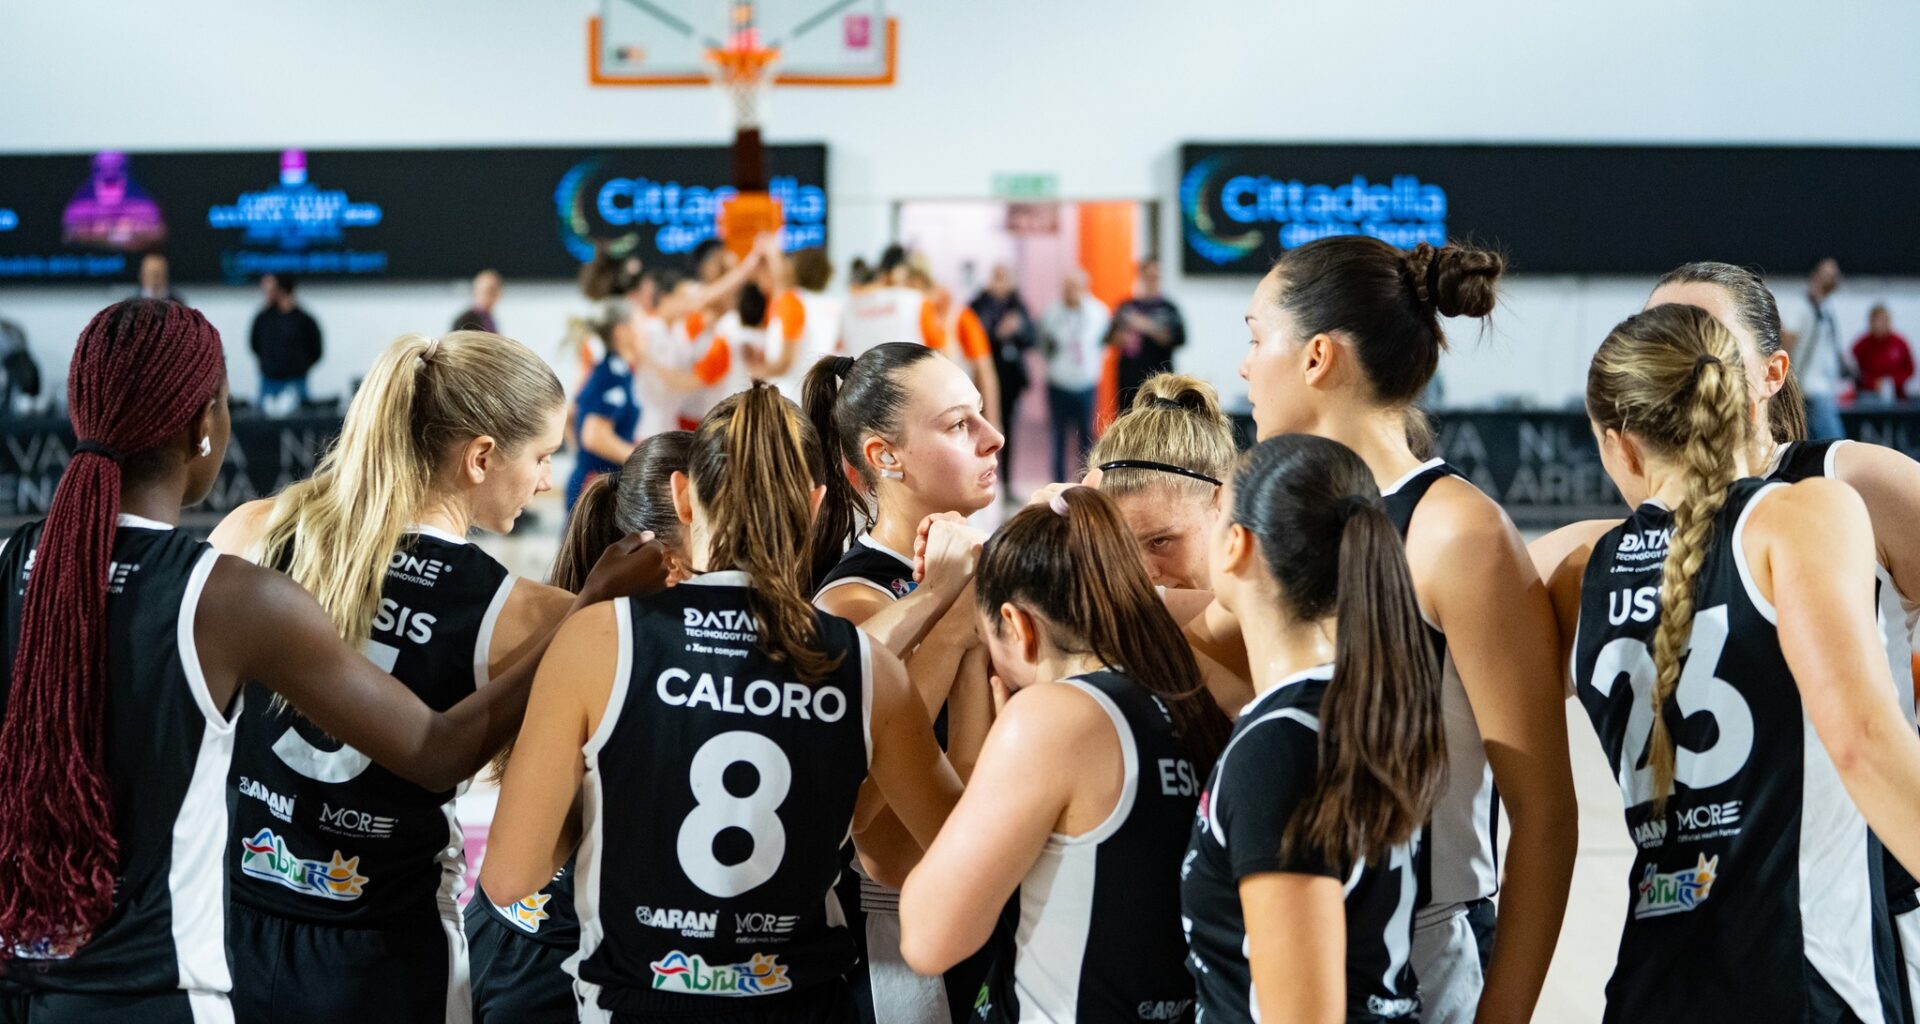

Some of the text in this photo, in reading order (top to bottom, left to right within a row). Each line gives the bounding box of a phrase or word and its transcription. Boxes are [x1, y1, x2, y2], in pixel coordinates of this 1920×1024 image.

[1608, 585, 1663, 626] US
[685, 627, 741, 641] TECHNOLOGY
[713, 646, 749, 659] company
[656, 667, 848, 723] CALORO
[319, 802, 395, 834] MORE
[676, 730, 792, 898] 8
[1676, 800, 1741, 831] MORE
[651, 908, 718, 931] ARAN
[735, 912, 796, 934] MORE
